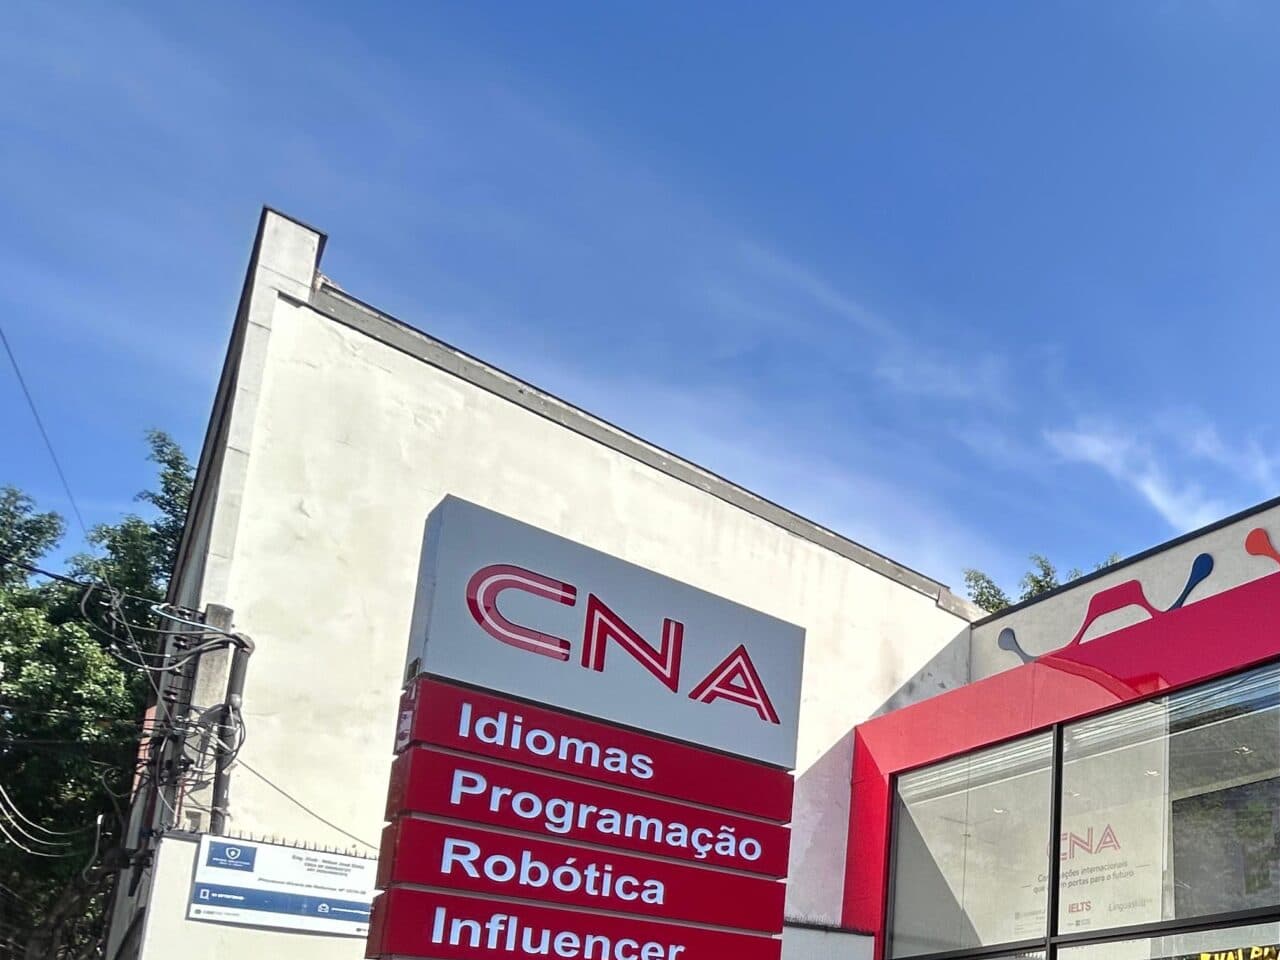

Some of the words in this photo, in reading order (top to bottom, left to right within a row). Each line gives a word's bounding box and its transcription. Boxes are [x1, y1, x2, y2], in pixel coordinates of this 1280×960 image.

[466, 563, 781, 725] CNA
[457, 702, 655, 780] Idiomas
[449, 768, 762, 861] Programação
[440, 837, 665, 905] Robótica
[1067, 900, 1092, 914] IELTS
